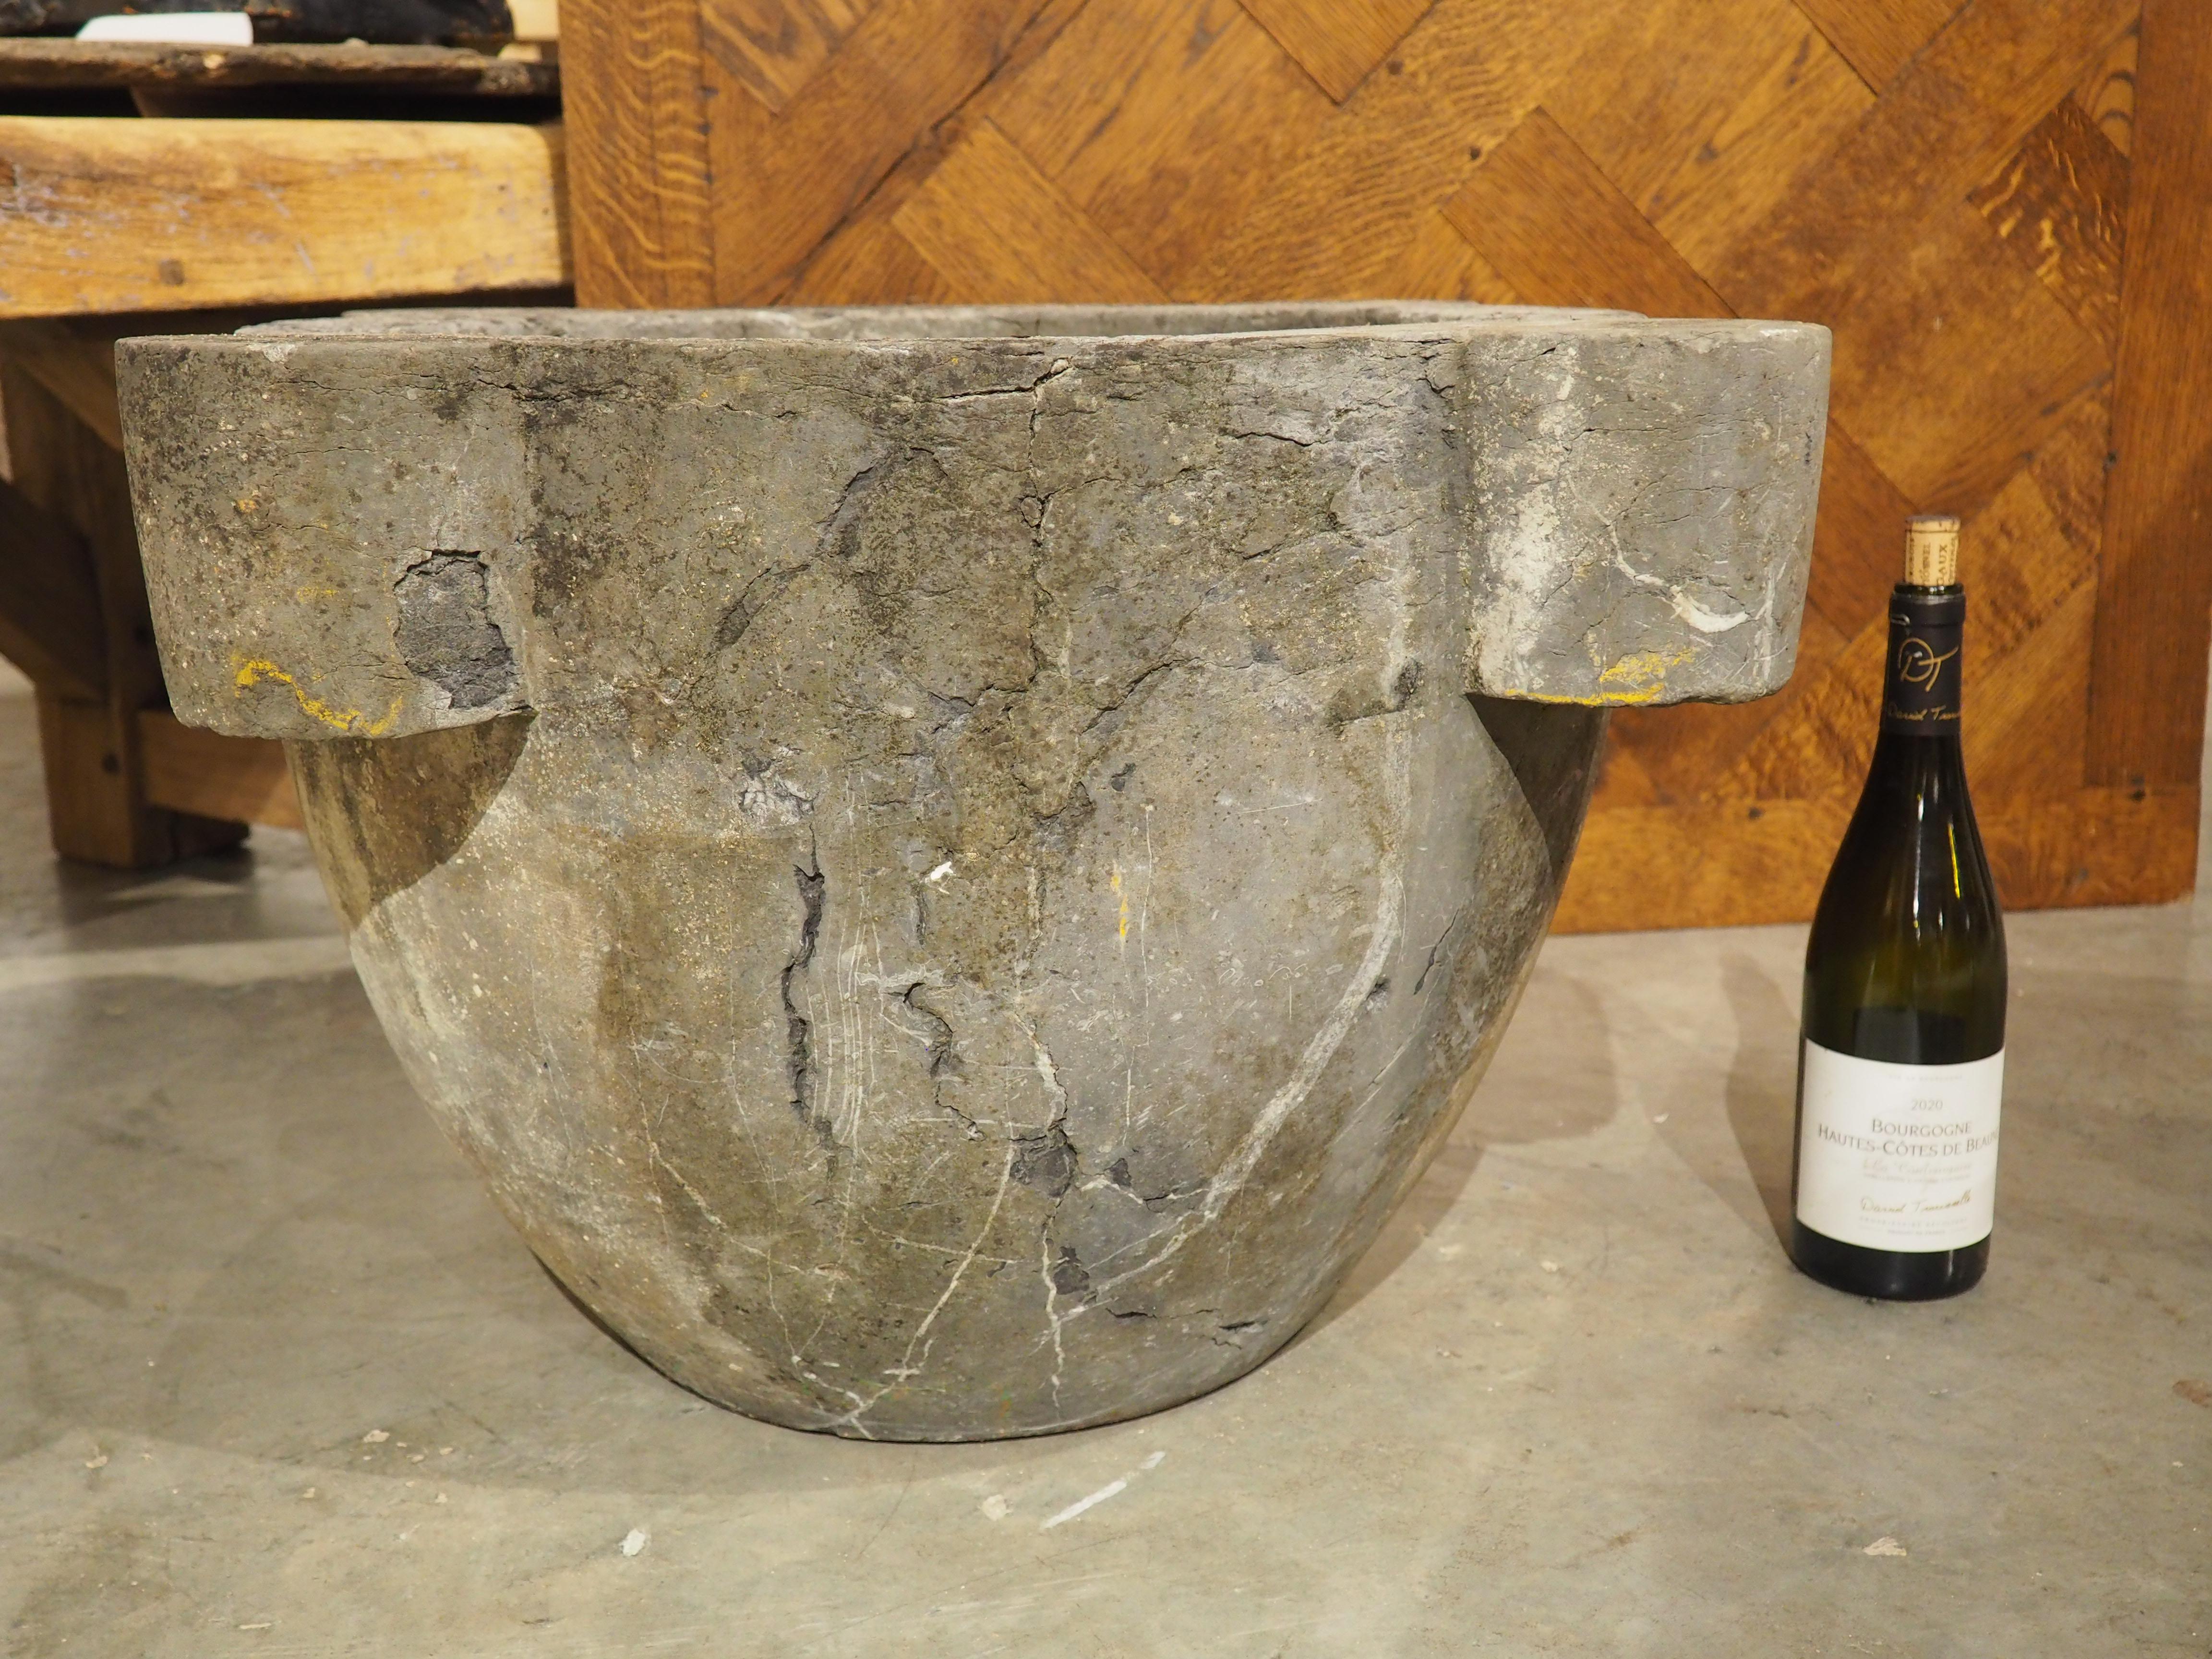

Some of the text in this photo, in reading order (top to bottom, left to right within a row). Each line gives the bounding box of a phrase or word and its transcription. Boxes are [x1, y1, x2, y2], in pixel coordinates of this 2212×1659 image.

[1912, 1099, 1943, 1111] 2020
[1872, 1118, 1972, 1137] BOURGOGNE
[1818, 1122, 1998, 1157] HAUTES-CÔTES DE BEAUN
